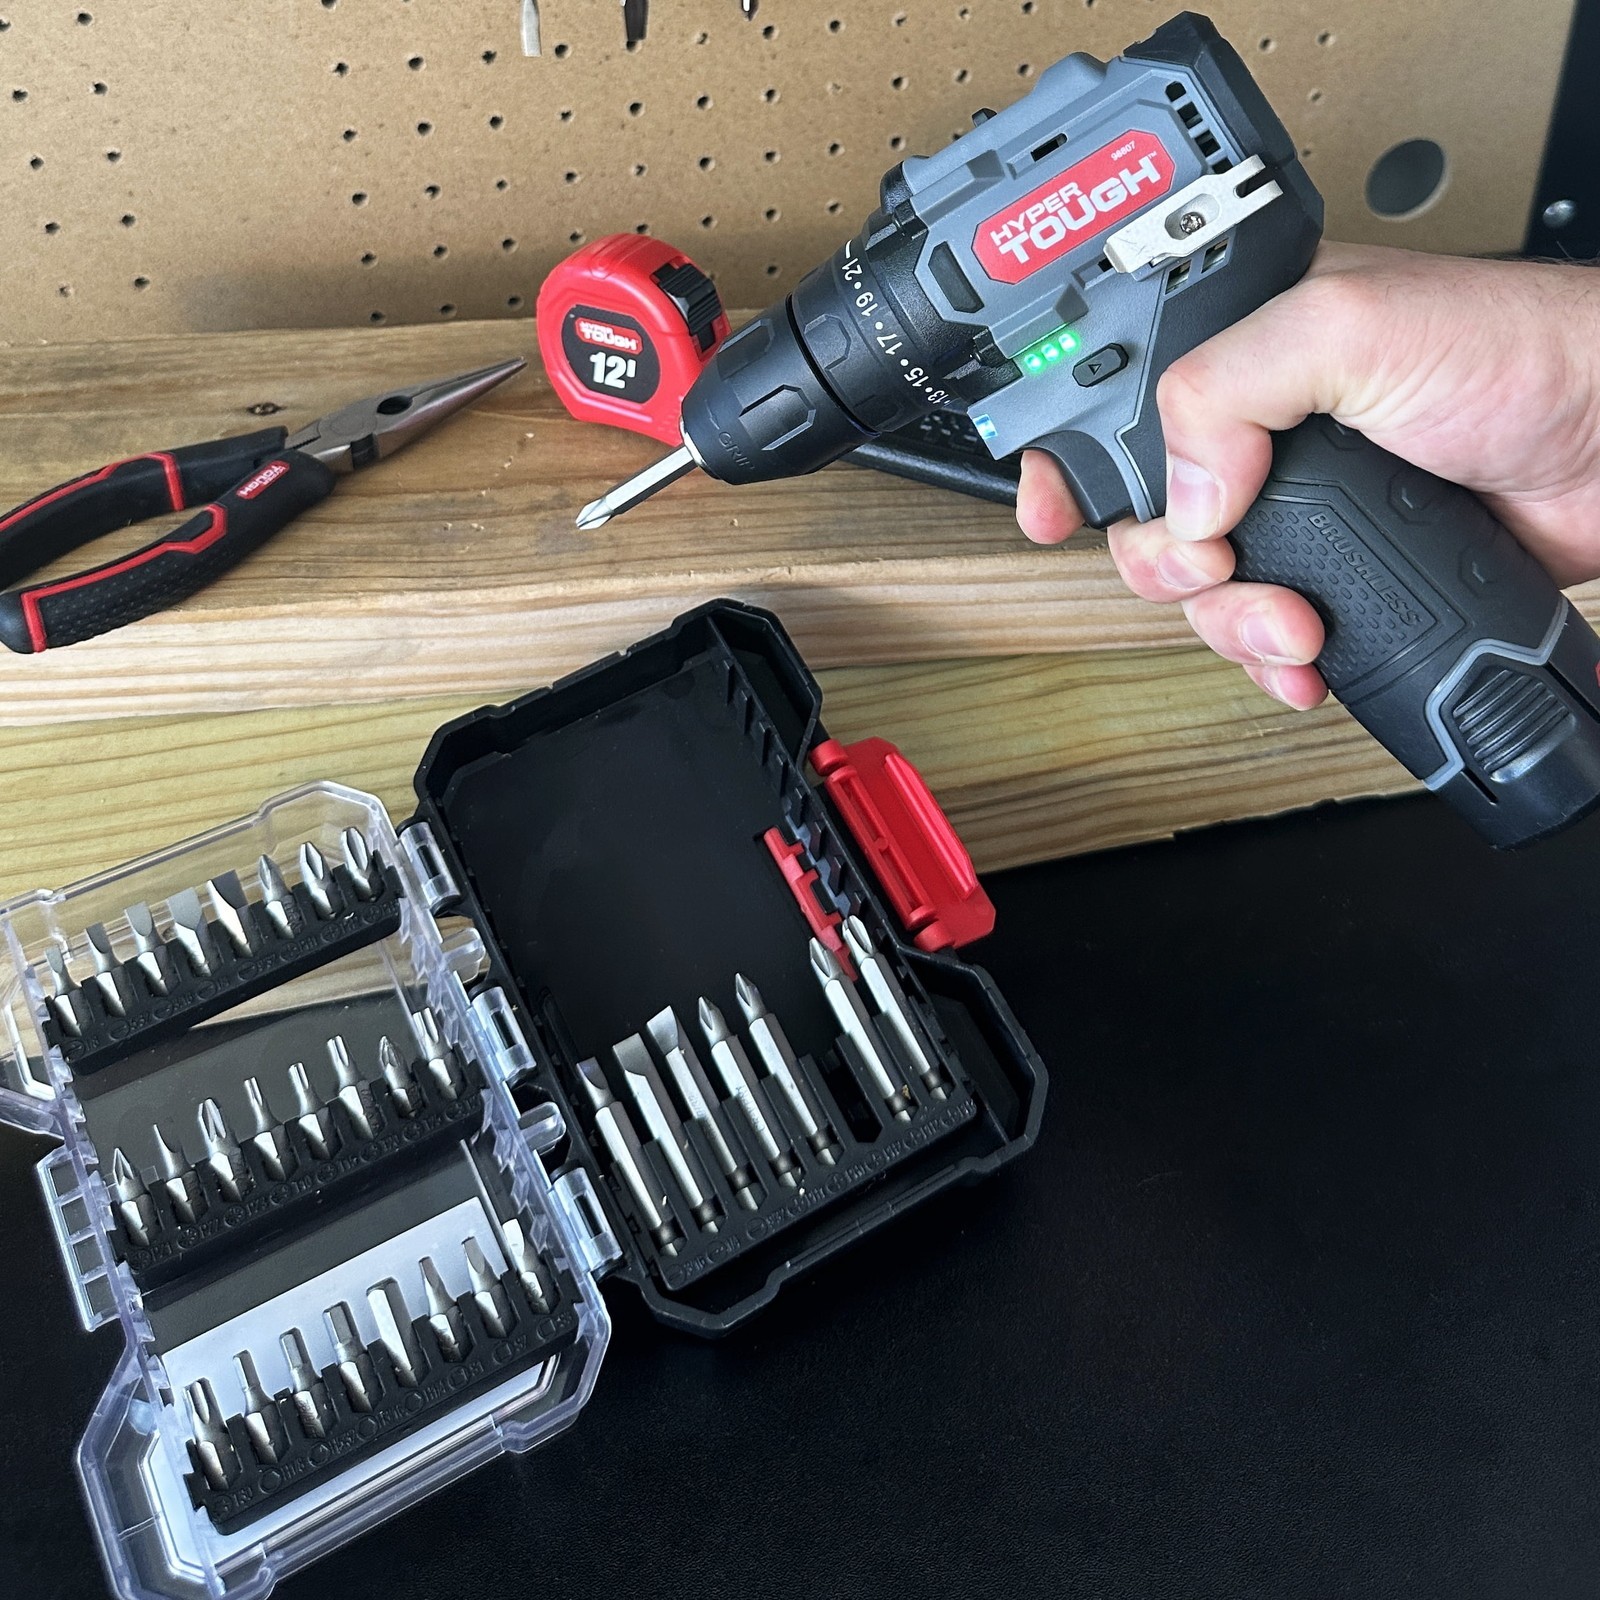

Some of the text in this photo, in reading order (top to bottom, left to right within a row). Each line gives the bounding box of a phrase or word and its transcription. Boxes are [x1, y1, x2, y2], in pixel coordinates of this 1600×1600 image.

[990, 181, 1083, 246] HYPER
[998, 155, 1161, 265] TOUGH
[589, 351, 636, 389] 12'
[842, 258, 949, 404] 13 15 17 19 21
[1308, 511, 1423, 626] BRUSHLESS
